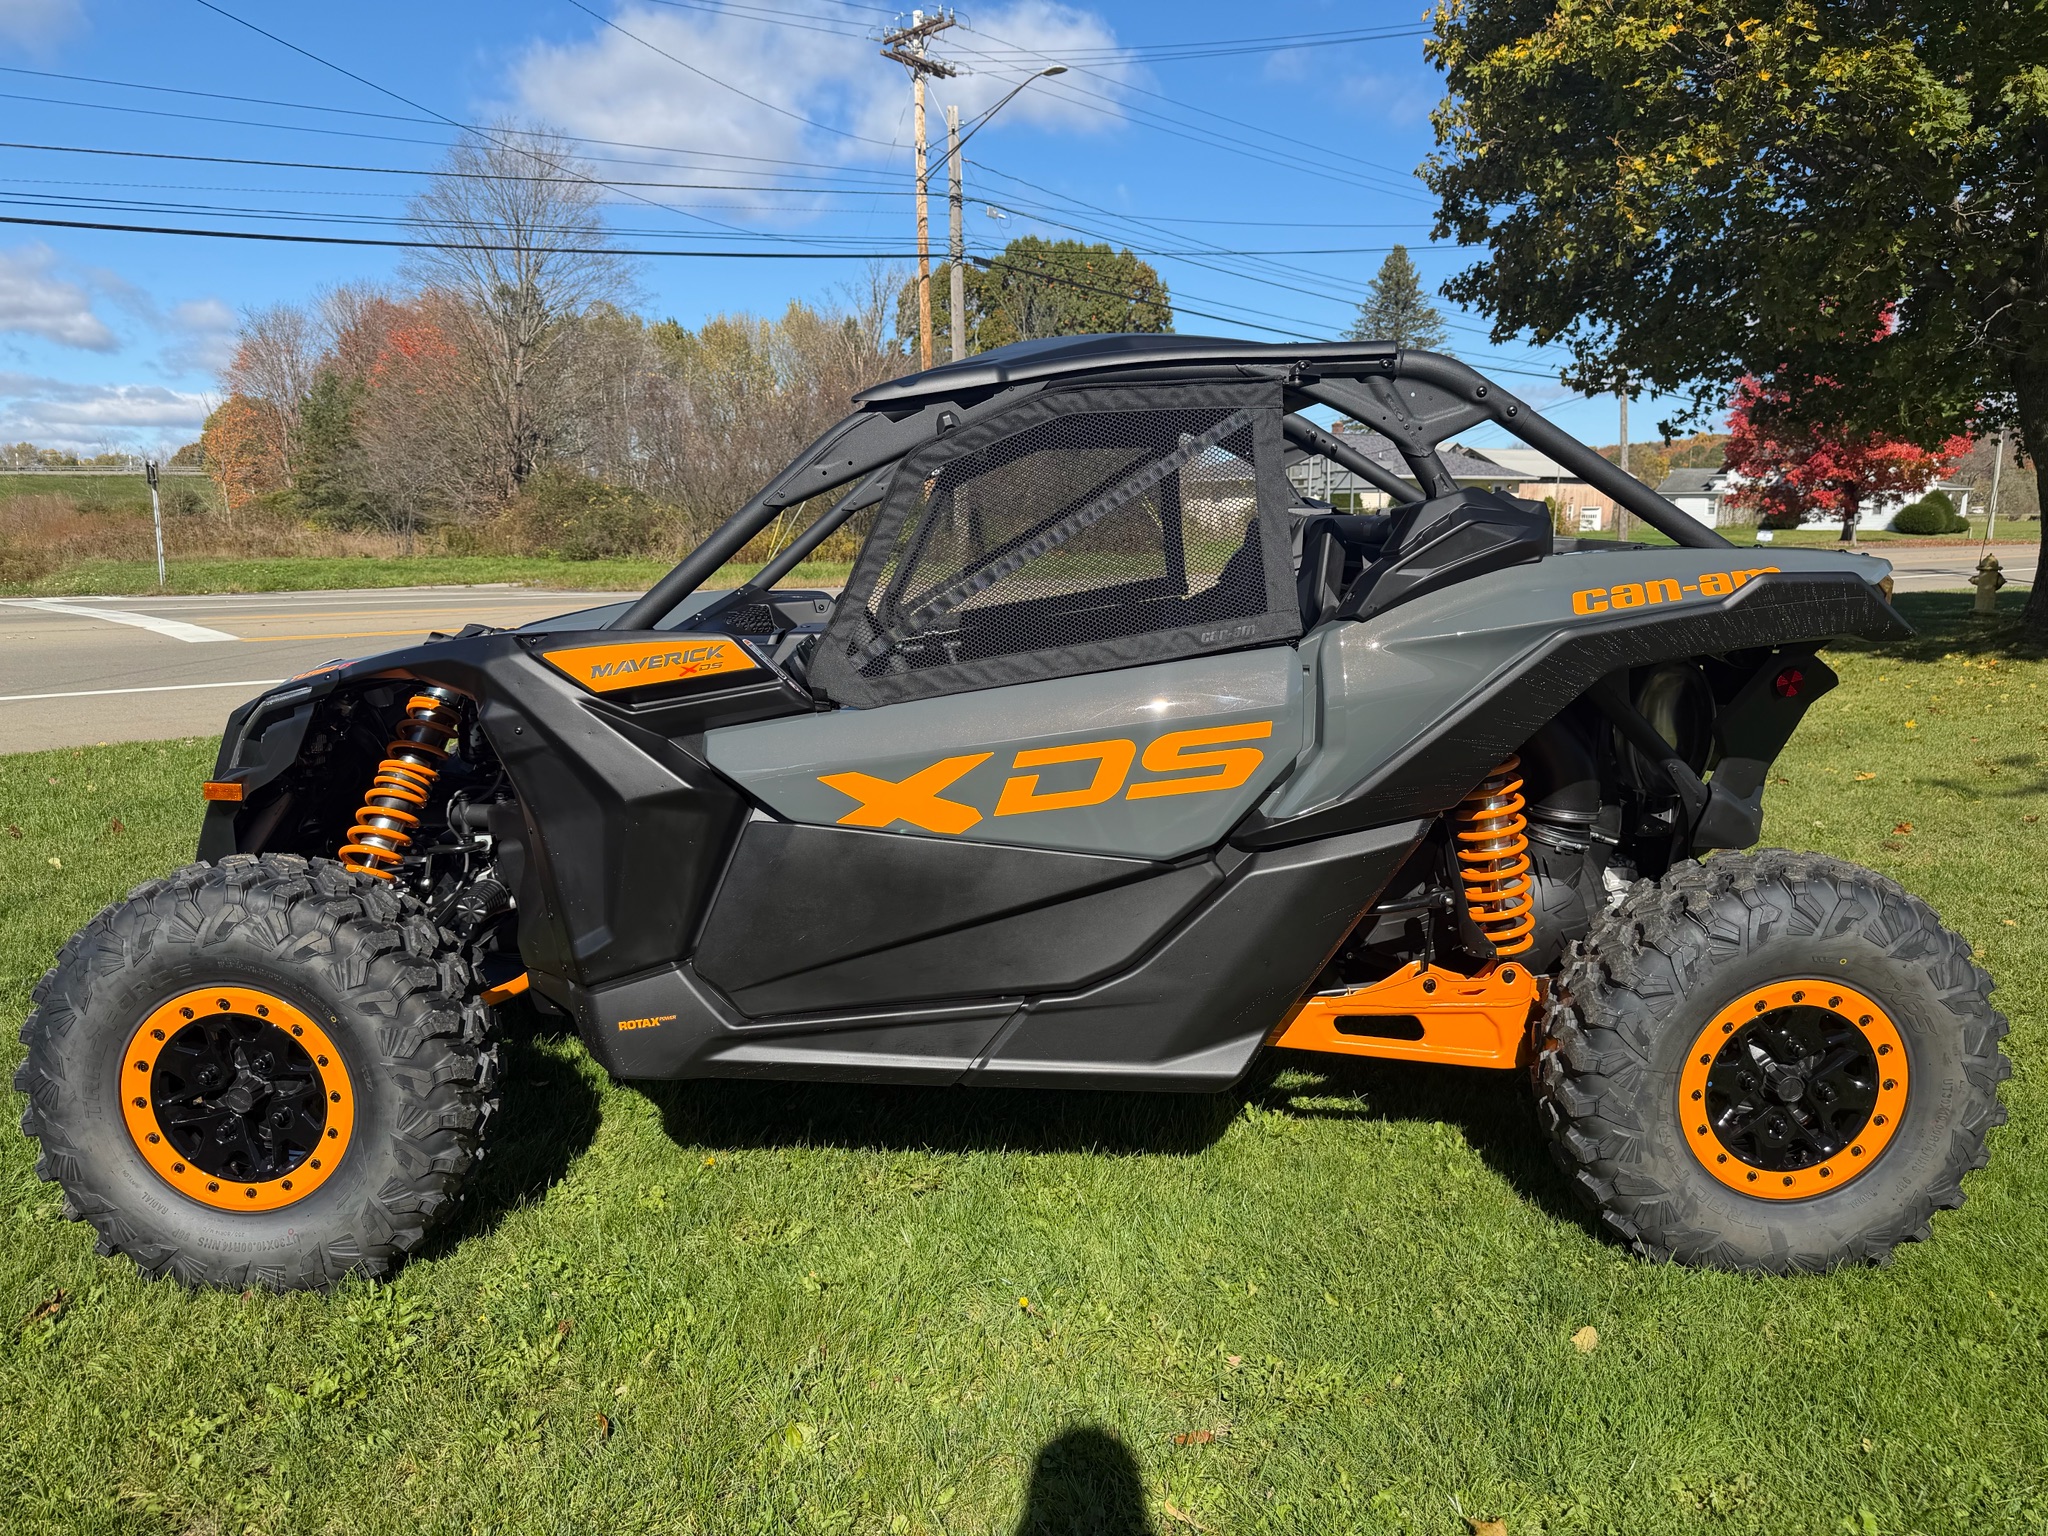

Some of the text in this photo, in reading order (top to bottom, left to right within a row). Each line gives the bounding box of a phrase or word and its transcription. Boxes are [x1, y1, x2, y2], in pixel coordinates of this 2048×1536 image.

[590, 644, 726, 679] MAVERICK
[816, 720, 1273, 835] XDS
[618, 1016, 660, 1031] ROTAX
